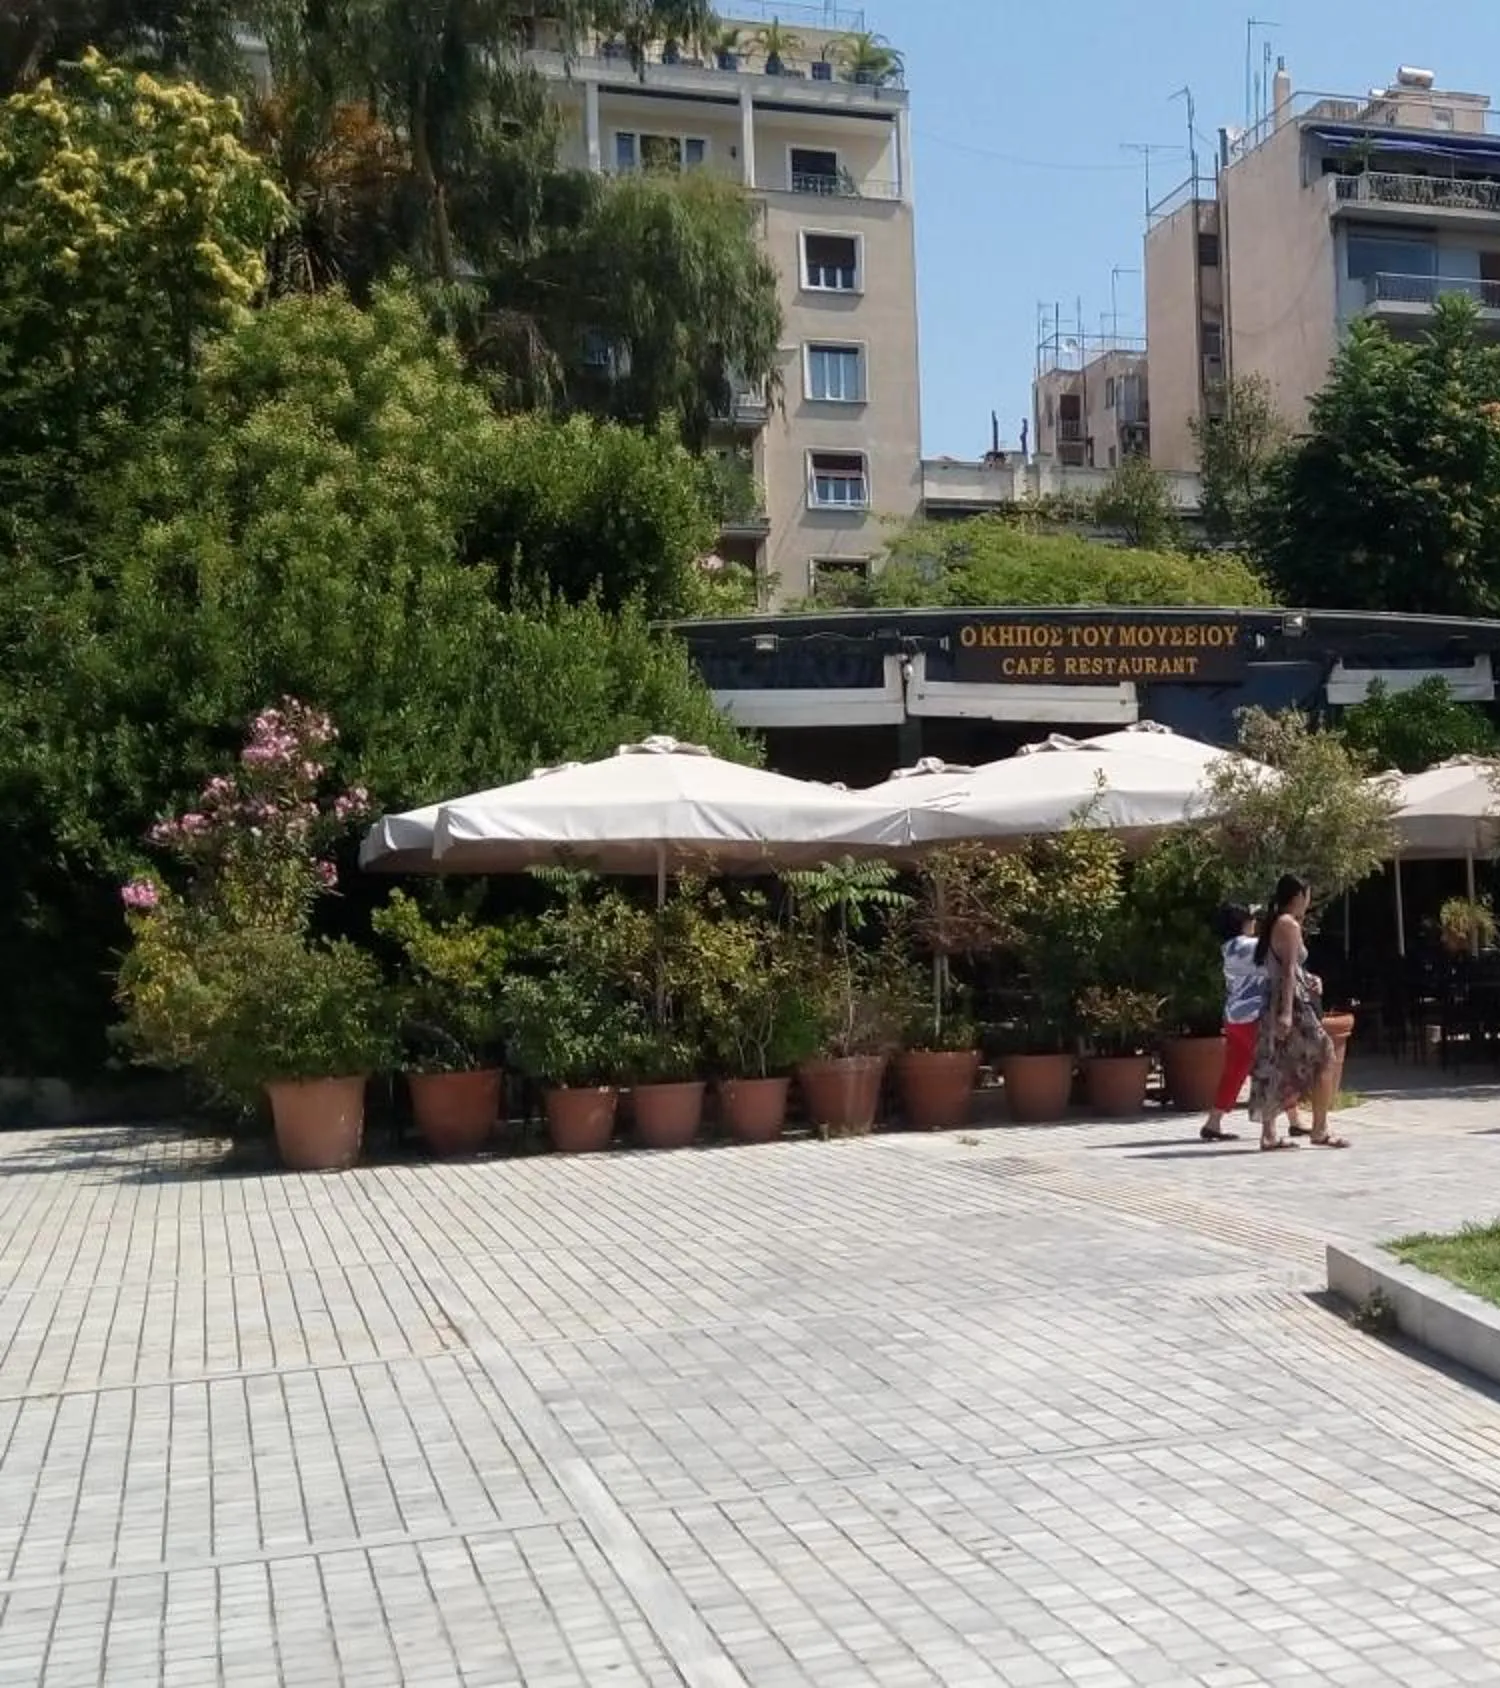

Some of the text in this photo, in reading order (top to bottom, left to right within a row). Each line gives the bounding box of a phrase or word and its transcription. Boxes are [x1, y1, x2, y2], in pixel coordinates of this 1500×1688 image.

[960, 624, 1239, 647] Ο ΚΗΠΟΣ ΤΟΥ ΜΟΥΣΕΙΟΥ
[1002, 650, 1198, 675] CAFÉ RESTAURANT
